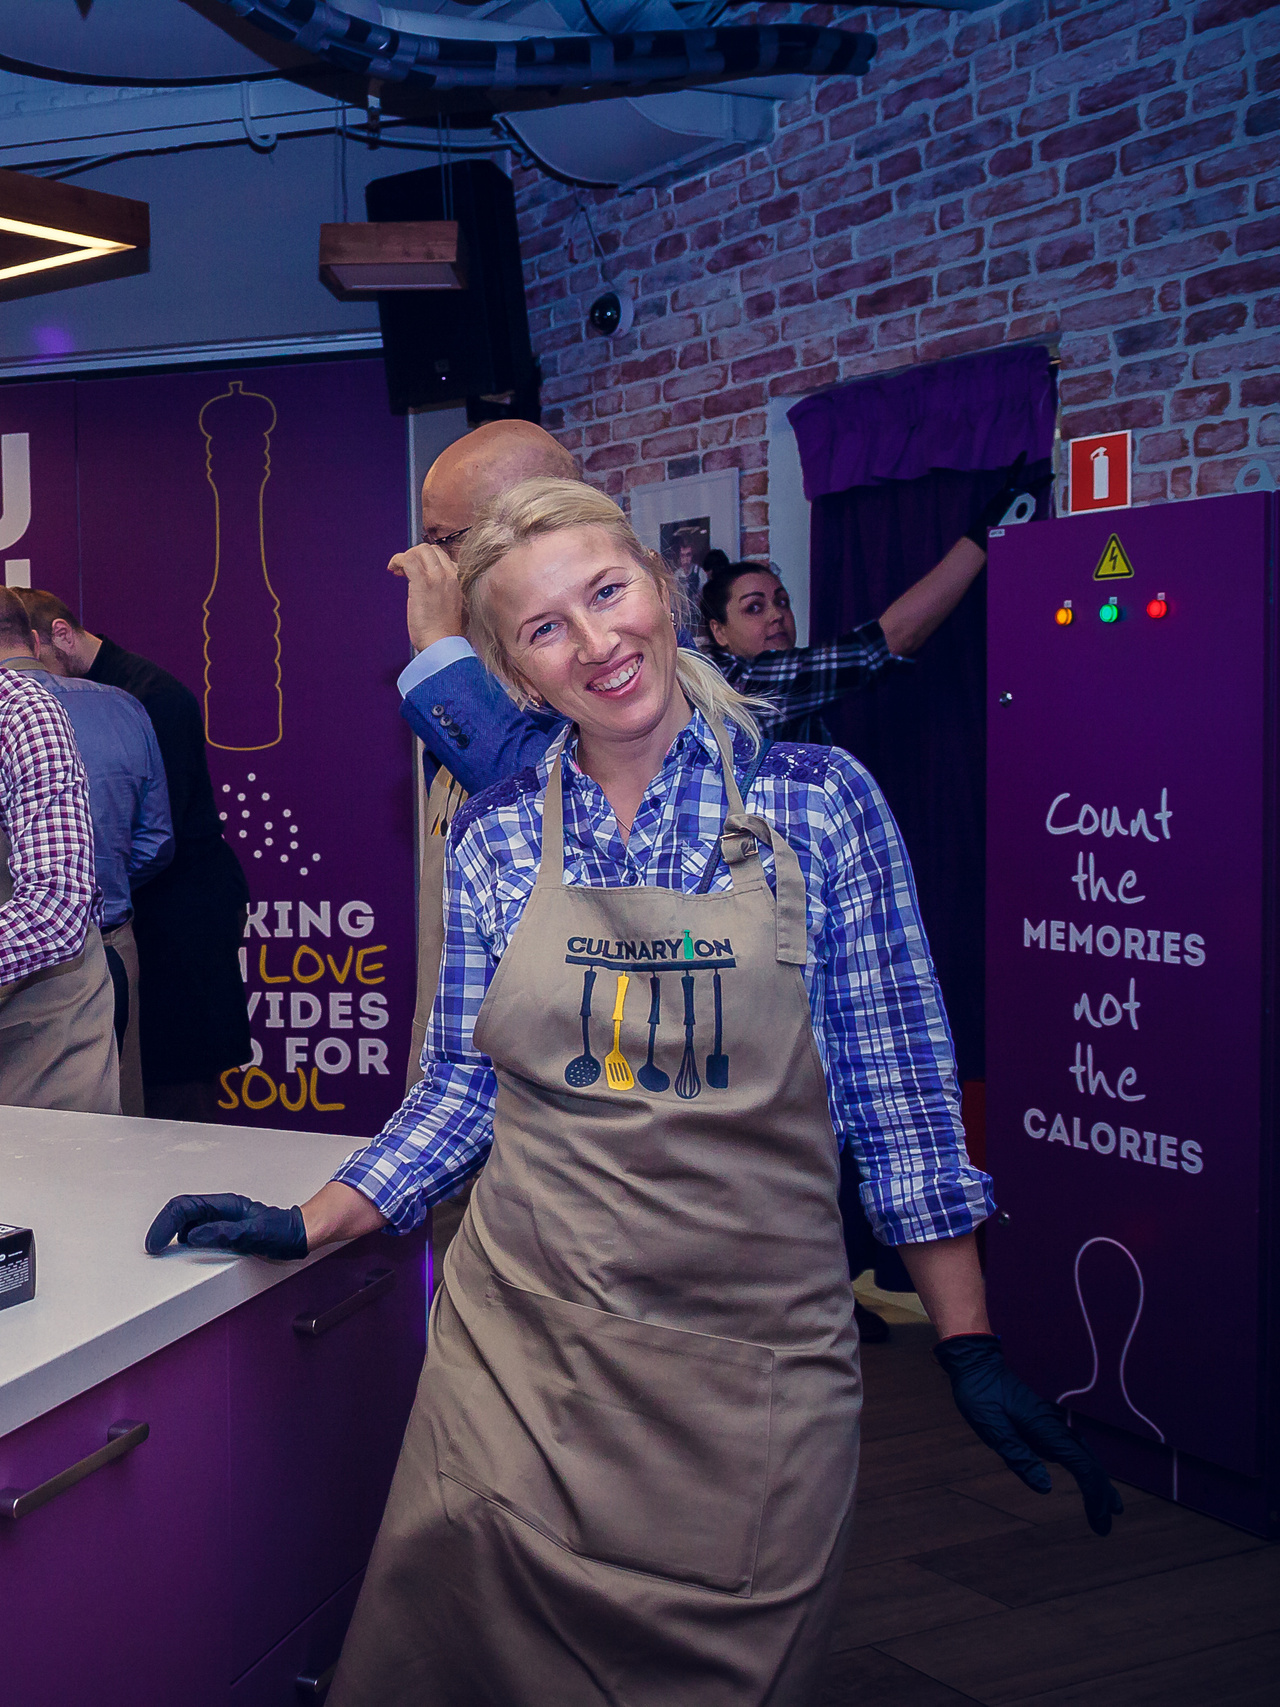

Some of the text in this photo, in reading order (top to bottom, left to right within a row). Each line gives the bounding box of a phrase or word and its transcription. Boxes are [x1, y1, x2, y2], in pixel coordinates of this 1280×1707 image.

[1045, 787, 1173, 843] Count
[1071, 851, 1146, 905] the
[259, 944, 388, 985] LOVE
[1023, 917, 1206, 967] MEMORIES
[1073, 977, 1141, 1031] not
[285, 1036, 391, 1075] FOR
[1069, 1041, 1147, 1102] the
[217, 1066, 346, 1112] SOUL
[1023, 1107, 1204, 1175] CALORIES
